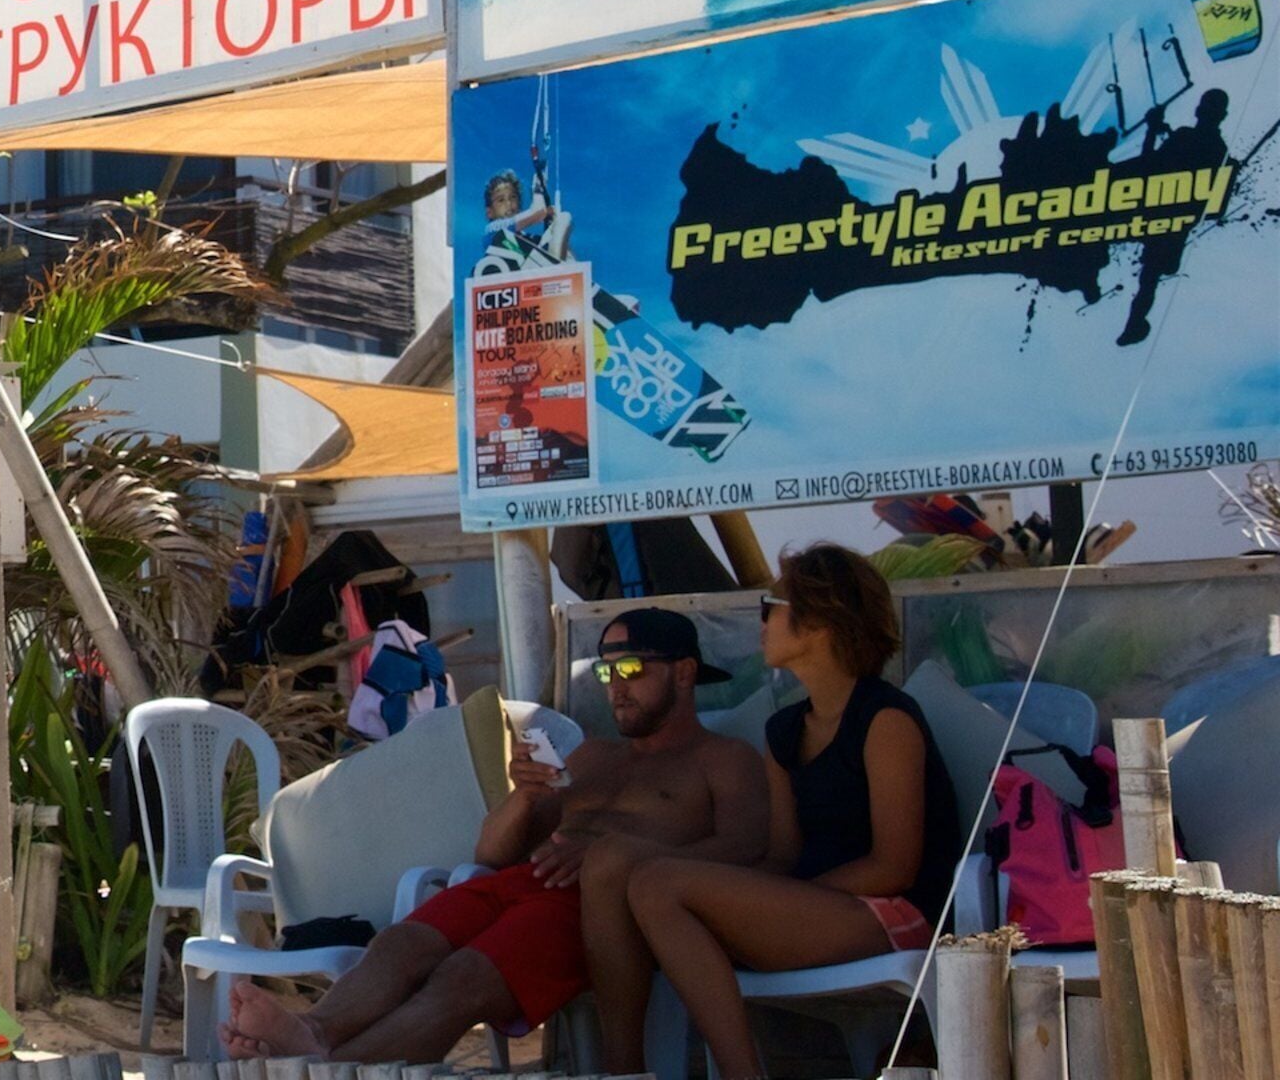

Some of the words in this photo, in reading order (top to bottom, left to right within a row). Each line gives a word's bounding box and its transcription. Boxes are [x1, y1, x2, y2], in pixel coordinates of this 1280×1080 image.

[671, 193, 946, 268] Freestyle
[958, 165, 1232, 231] Academy
[891, 227, 1050, 268] kitesurf
[1058, 213, 1195, 246] center
[476, 287, 518, 311] ICTSI
[476, 306, 540, 330] PHILIPPINE
[476, 347, 516, 364] TOUR
[522, 483, 753, 520] WWW.FREESTYLE-BORACAY.COM
[805, 456, 1064, 500] INFO@FREESTYLE-BORACAY.COM
[1112, 450, 1146, 472] +63
